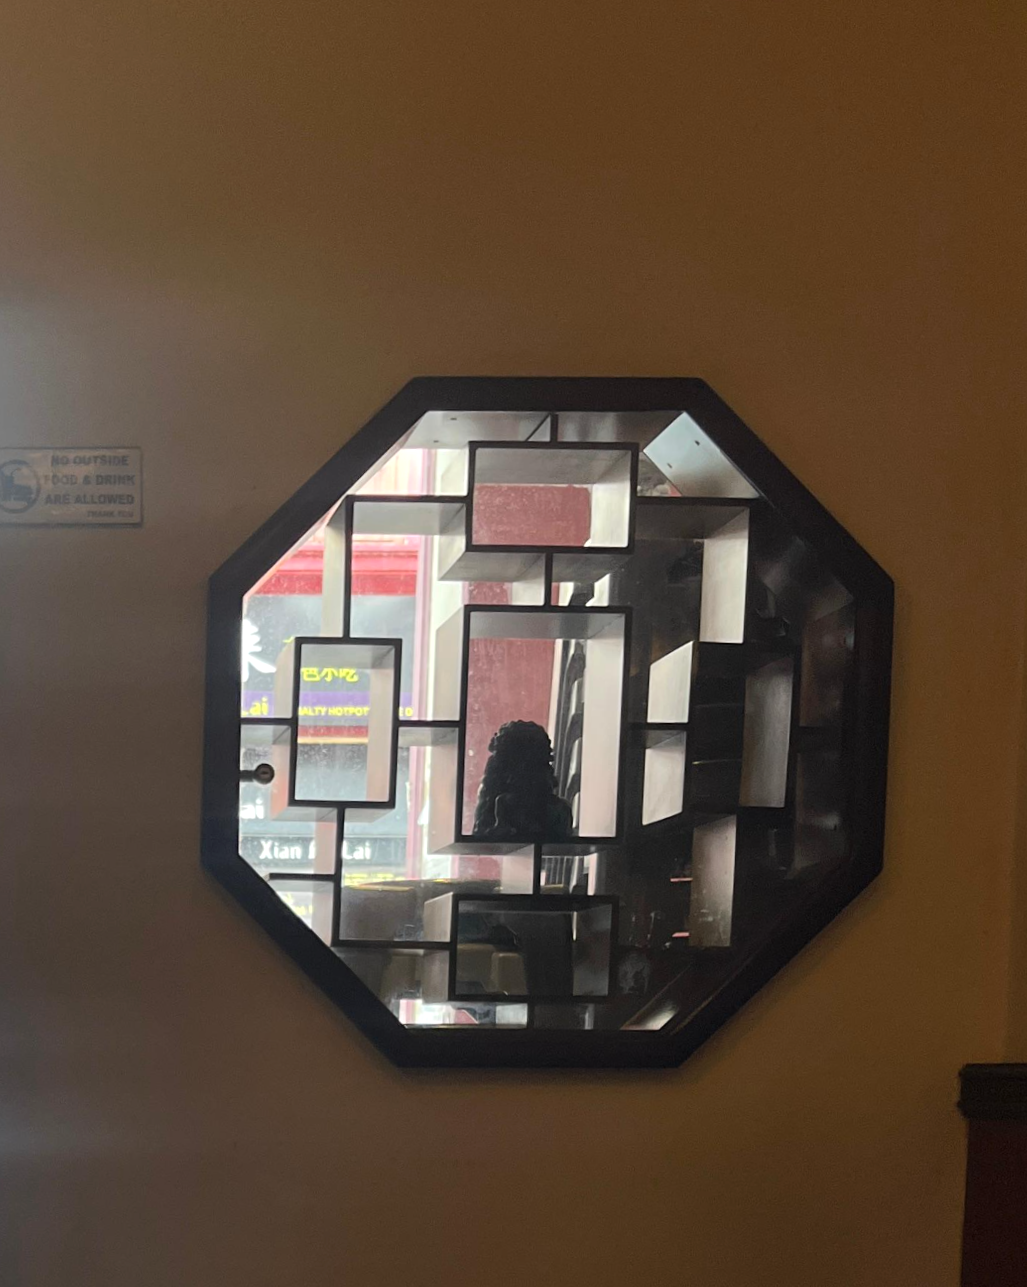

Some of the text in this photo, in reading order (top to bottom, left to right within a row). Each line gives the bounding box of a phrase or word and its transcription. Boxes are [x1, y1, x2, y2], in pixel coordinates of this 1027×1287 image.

[51, 455, 130, 466] NO OUTSIDE
[44, 474, 136, 485] FOOD & DRINK
[44, 493, 135, 505] ARE ALLOWED
[259, 840, 302, 860] Xian
